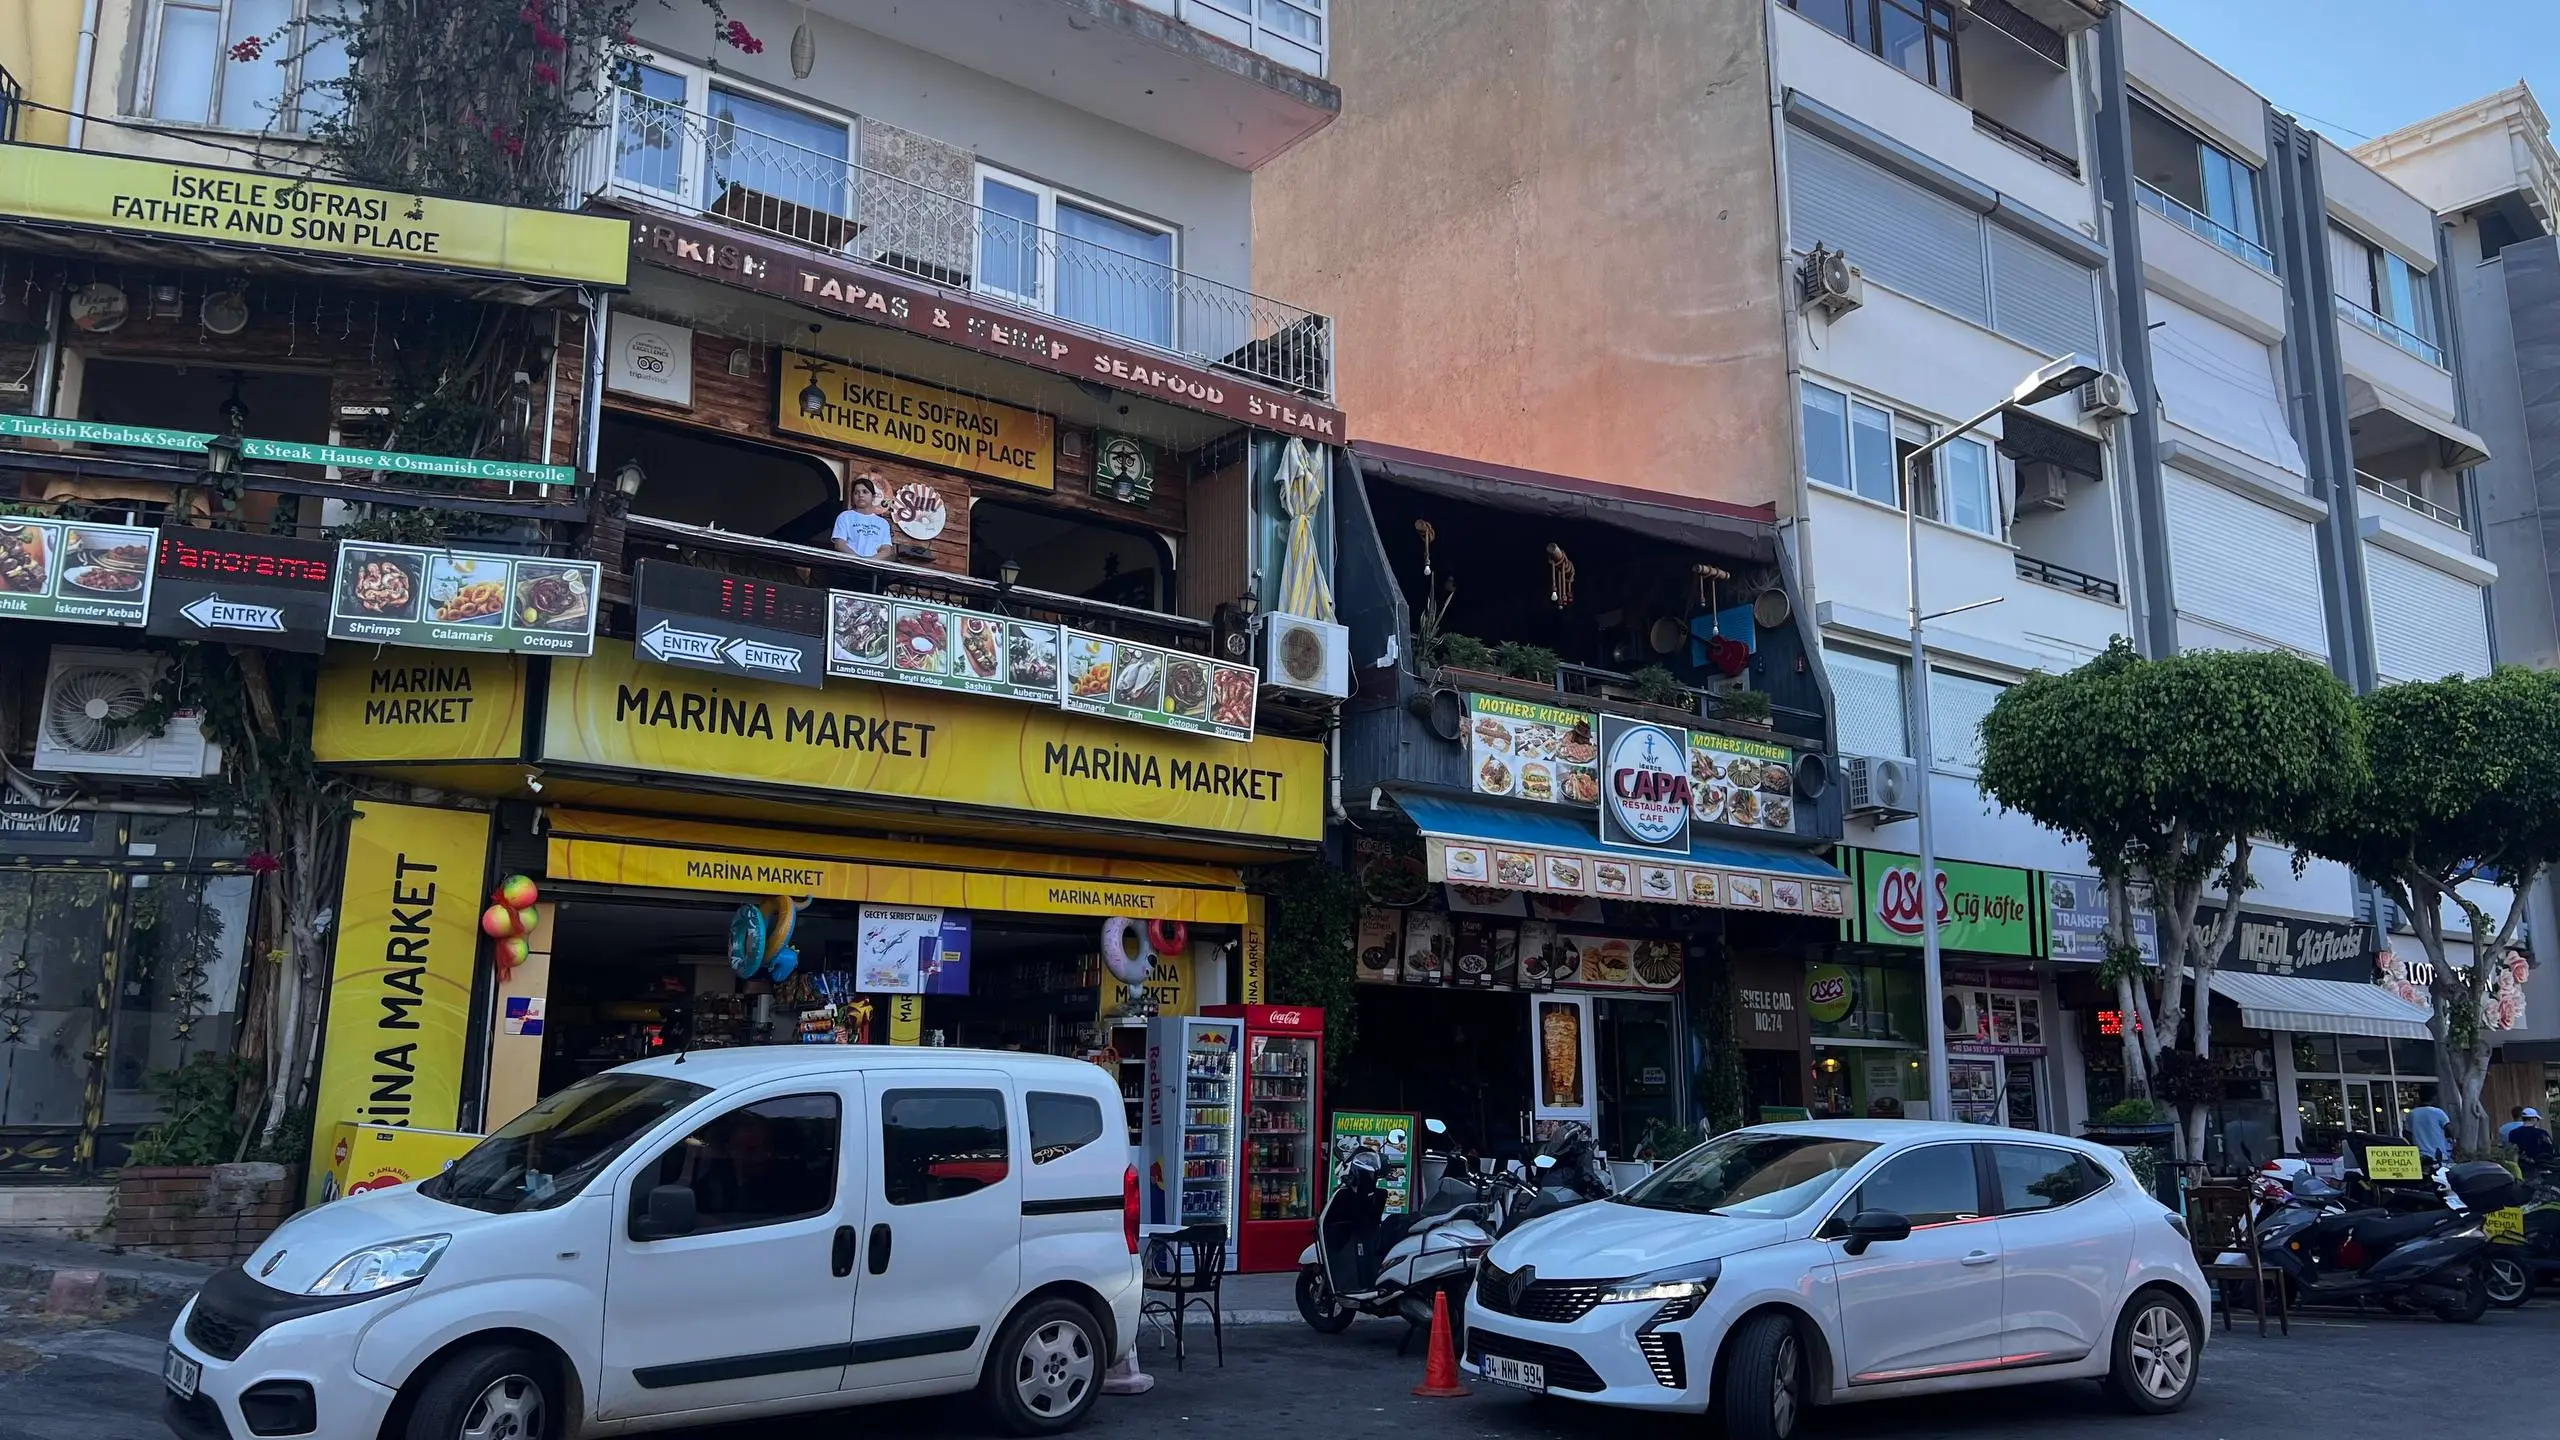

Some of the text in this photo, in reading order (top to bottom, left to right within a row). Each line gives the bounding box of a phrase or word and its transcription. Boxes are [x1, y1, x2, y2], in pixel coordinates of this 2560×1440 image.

[171, 169, 387, 222] İSKELE SOFRASI
[112, 195, 441, 253] FATHER AND SON PLACE
[799, 271, 909, 319] TAPAS
[931, 307, 951, 330] &
[1093, 353, 1225, 405] SEAFOOD
[1248, 394, 1335, 437] STEAK
[842, 376, 999, 438] İSKELE SOFRASI
[10, 418, 76, 437] Turkish
[884, 418, 927, 446] AND
[931, 428, 971, 456] SON
[976, 438, 1036, 471] PLACE
[244, 442, 566, 482] & Steak Hause & Osmanish Casserolle
[106, 605, 142, 619] Kebab
[211, 605, 267, 623] ENTRY
[349, 622, 401, 637] Shrimps
[431, 628, 494, 643] Calamaris
[523, 634, 574, 649] Octopus
[663, 635, 709, 654] ENTRY
[745, 649, 789, 667] ENTRY
[836, 664, 857, 675] Lamb
[369, 661, 473, 694] MARİNA
[1013, 687, 1054, 701] Aubergine
[364, 697, 474, 726] MARKET
[615, 683, 936, 759] MARİNA MARKET
[1127, 709, 1144, 721] Fish
[1478, 697, 1590, 725] MOTHERS KITCHEN
[1692, 733, 1786, 760] MOTHERS KITCHEN
[1044, 740, 1284, 802] MARİNA MARKET
[1614, 768, 1695, 808] CAPA
[1622, 800, 1681, 815] RESTAURANT
[1639, 813, 1664, 823] CAFE
[687, 859, 824, 887] MARİNA MARKET
[1048, 887, 1156, 910] MARİNA MARKET
[1953, 892, 2025, 926] Çiğ köfte
[864, 910, 888, 920] GECEYE
[889, 911, 915, 921] SERBEST
[377, 853, 438, 1030] MARKET
[1248, 929, 1259, 977] MARKET
[1115, 985, 1180, 1005] MRKET
[1772, 991, 1794, 1011] CAD.
[1754, 1011, 1783, 1032] NO:74
[1150, 1046, 1161, 1126] Red Bull
[1336, 1117, 1409, 1132] MOTHERS KITCHEN
[1486, 1357, 1497, 1377] 34
[1523, 1364, 1542, 1386] 994
